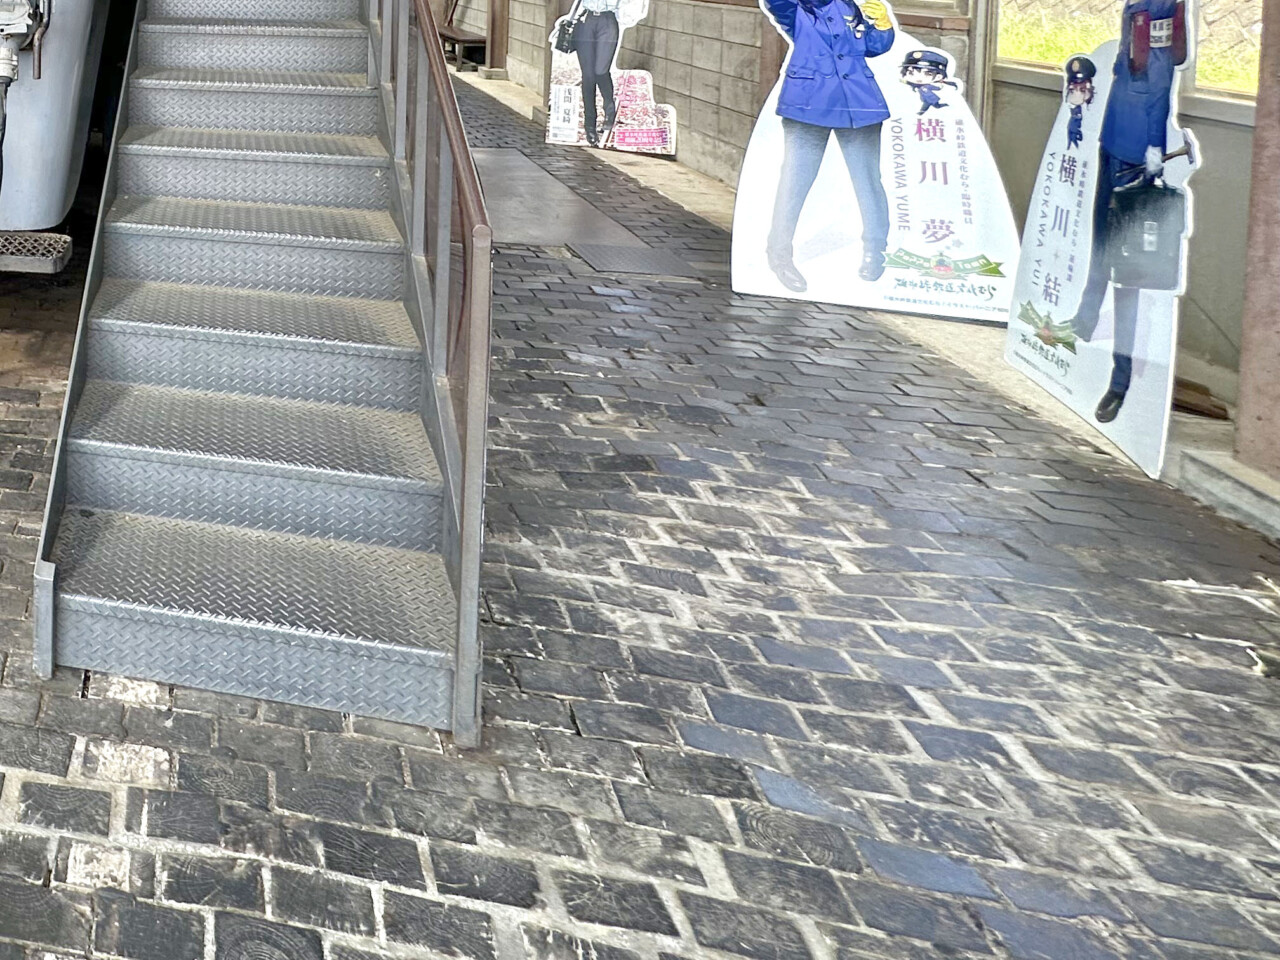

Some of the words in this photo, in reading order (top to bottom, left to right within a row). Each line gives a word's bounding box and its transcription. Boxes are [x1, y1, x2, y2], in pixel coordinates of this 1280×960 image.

[890, 117, 908, 189] YOKOKAWA
[895, 194, 911, 231] YUME
[1036, 151, 1057, 248] YOKOKAWA
[1031, 258, 1043, 286] YUI
